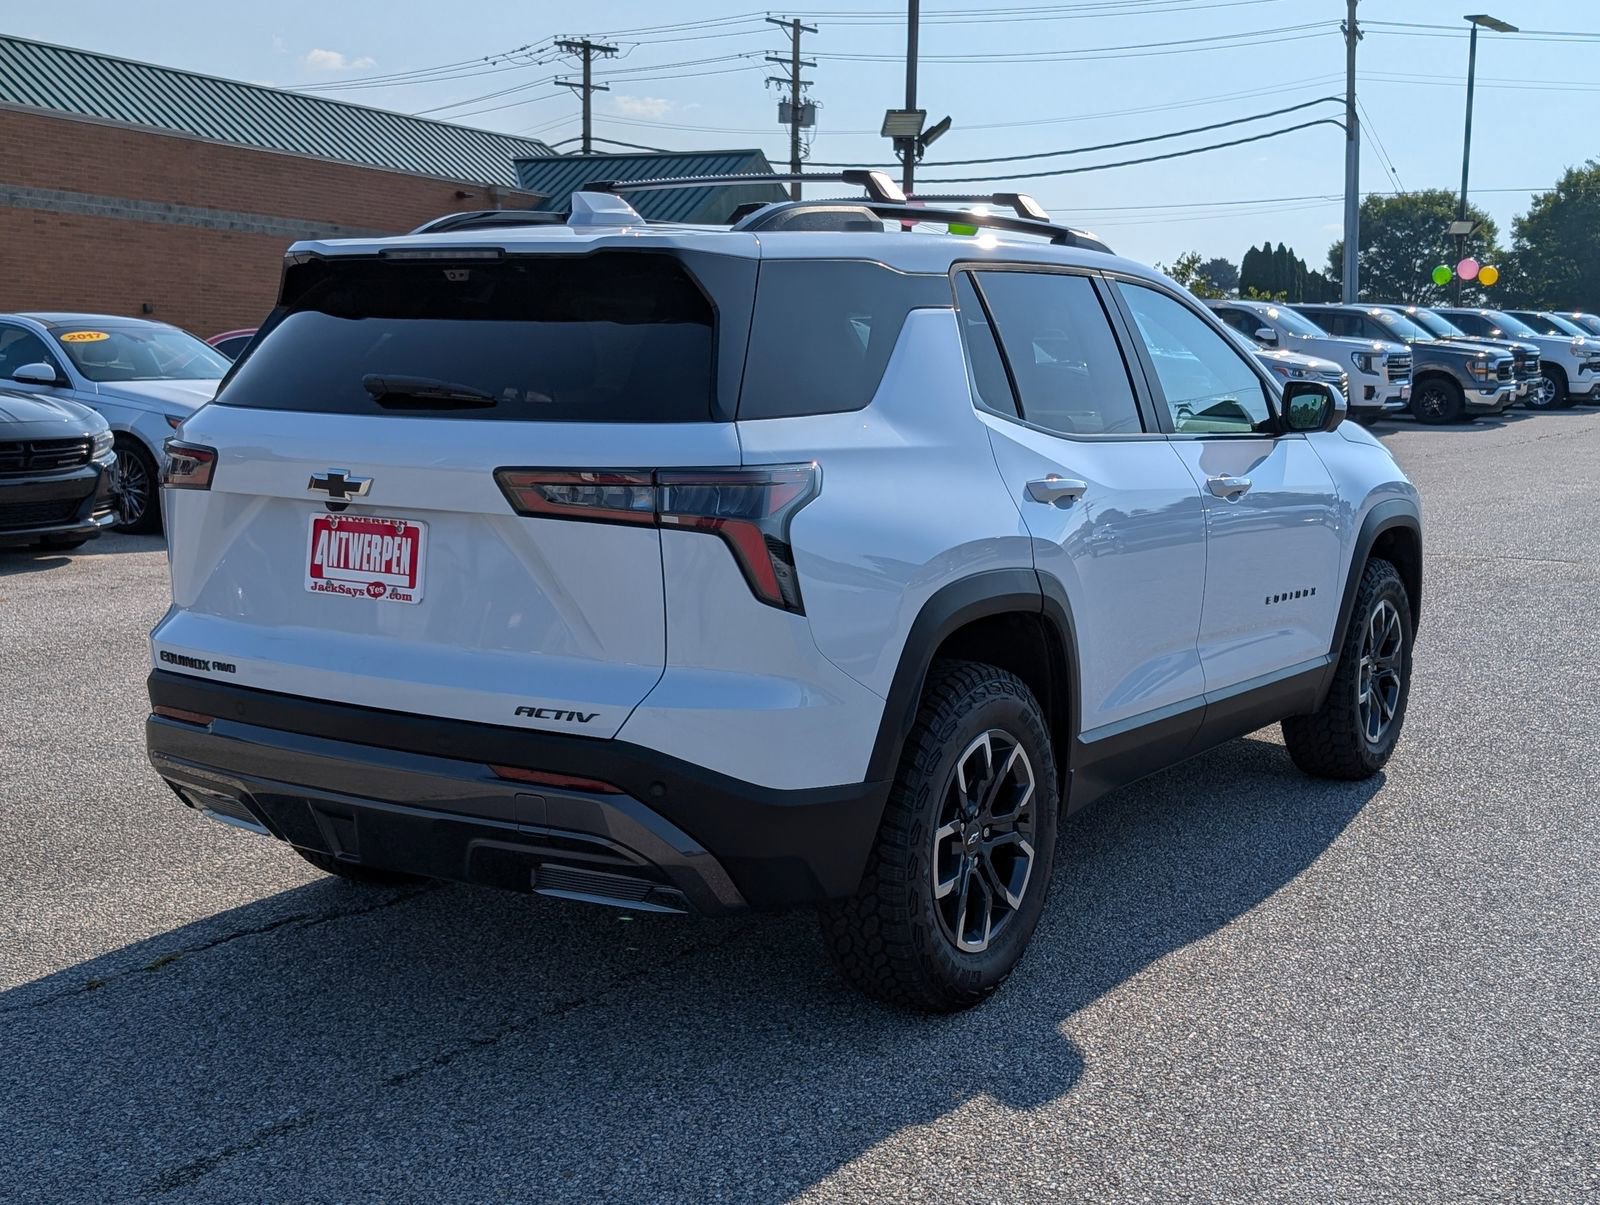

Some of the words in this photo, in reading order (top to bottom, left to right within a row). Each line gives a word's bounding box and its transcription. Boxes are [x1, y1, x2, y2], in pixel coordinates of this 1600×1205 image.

[67, 333, 101, 341] 2017
[325, 514, 408, 527] ANTWERPEN
[314, 530, 412, 576] ANTWERPEN
[160, 650, 211, 671] EQUINOX
[212, 661, 236, 673] AWD
[514, 705, 600, 723] ACTIV
